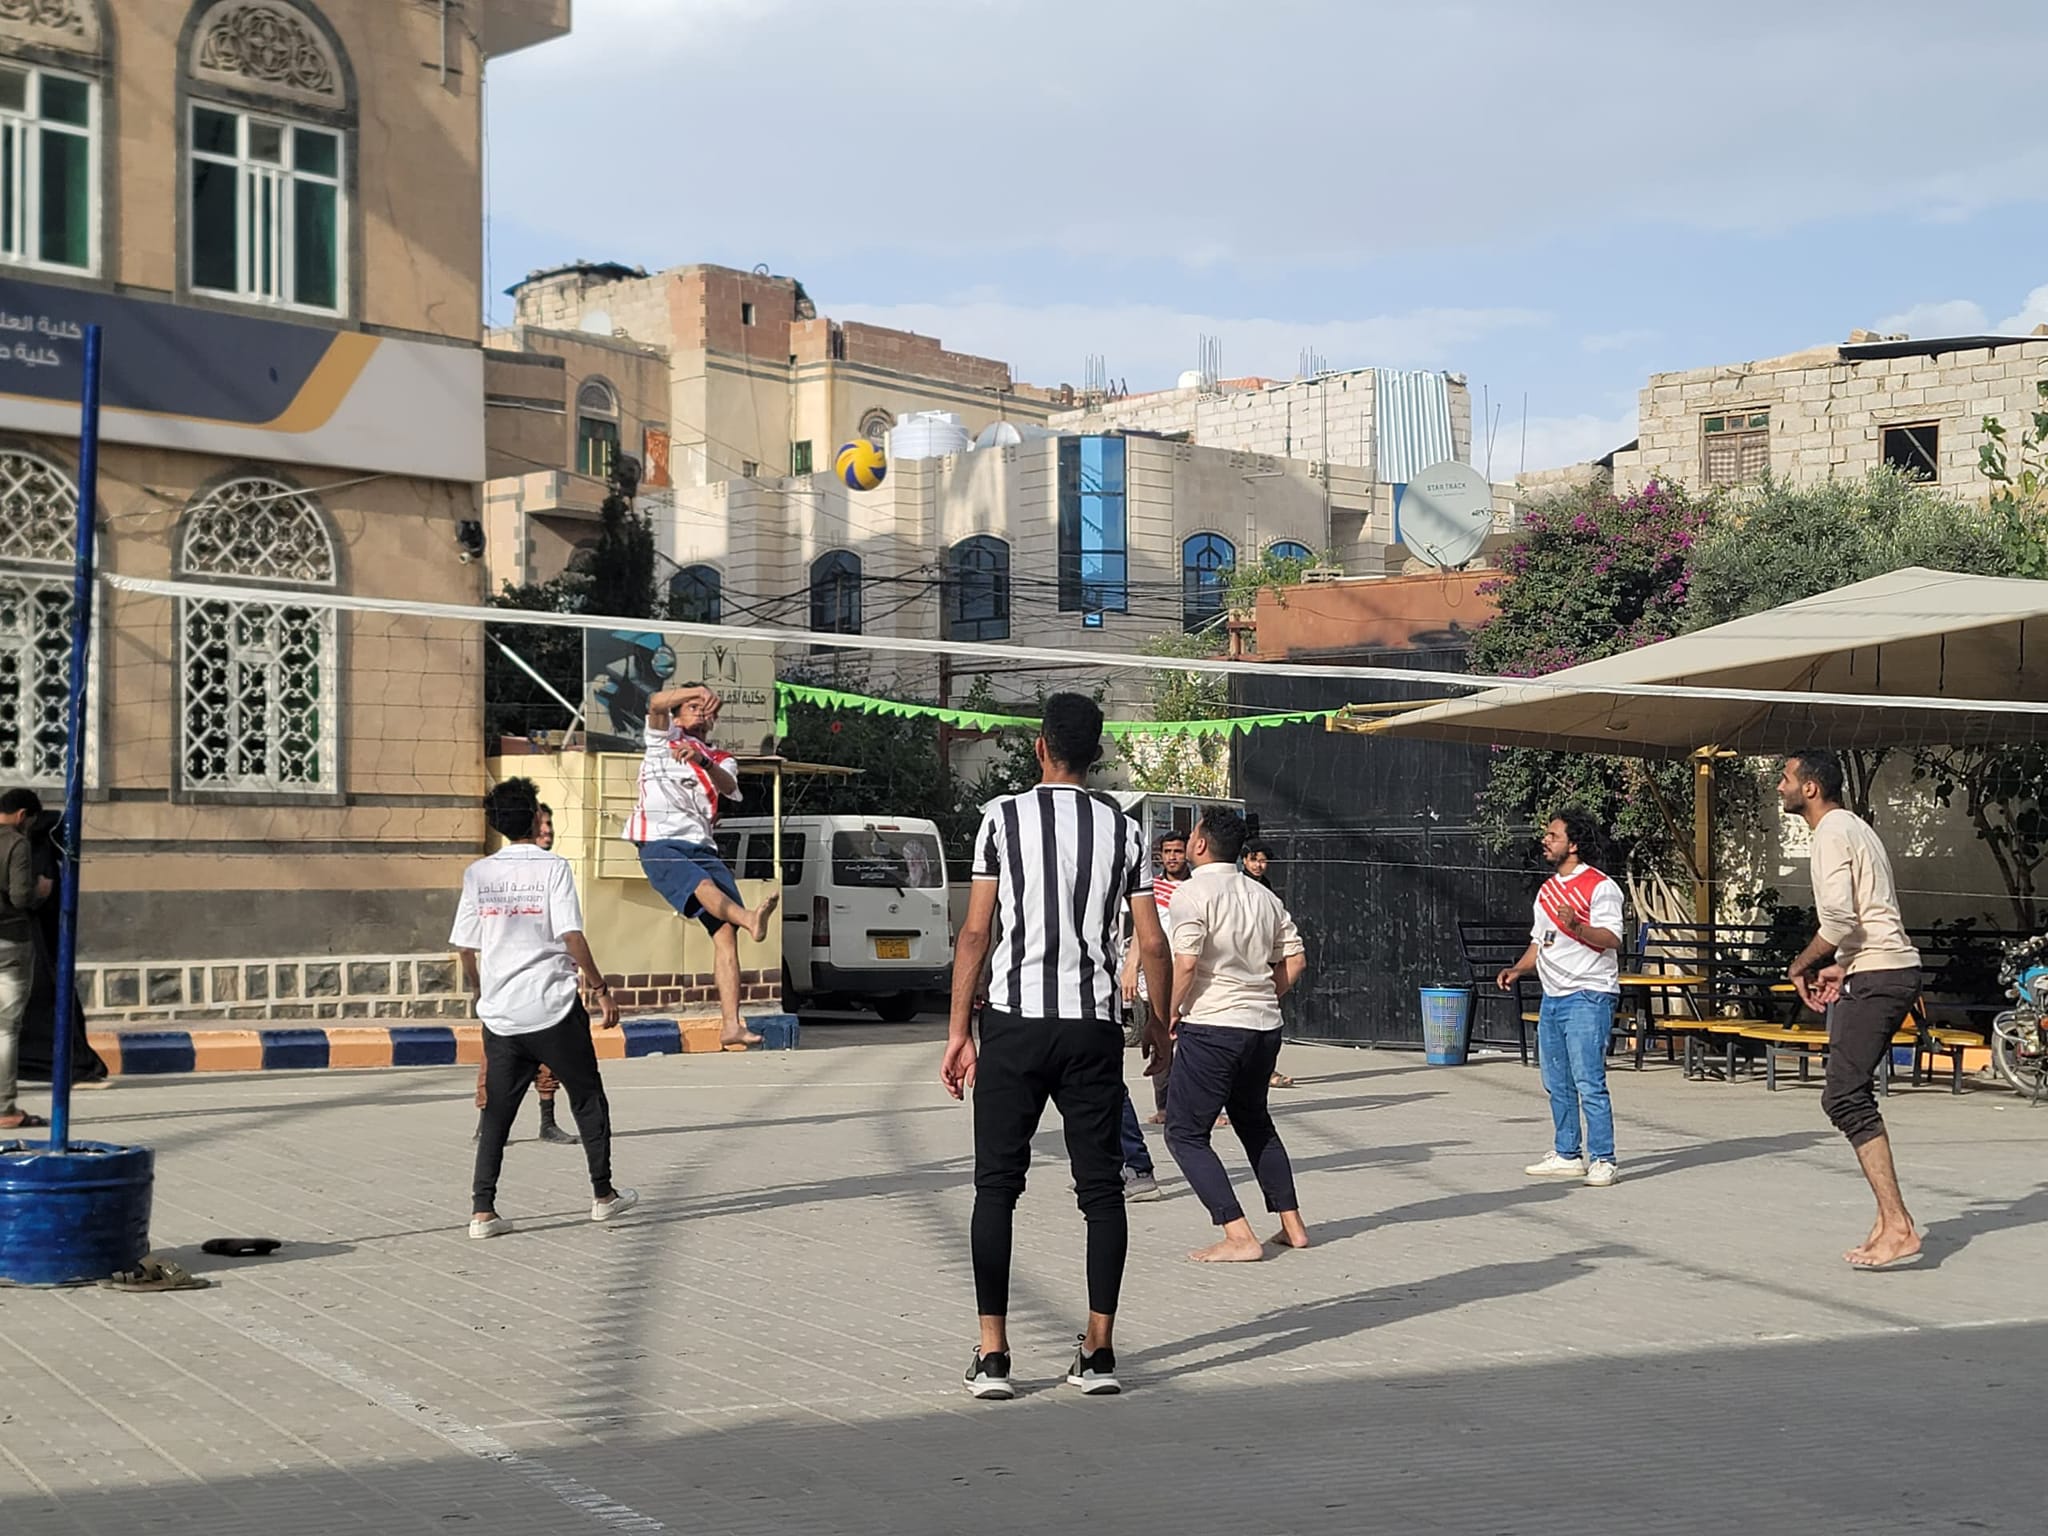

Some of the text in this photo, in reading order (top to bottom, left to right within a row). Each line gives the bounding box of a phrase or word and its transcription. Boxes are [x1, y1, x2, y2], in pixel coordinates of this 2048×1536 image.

[38, 316, 82, 340] كلية
[15, 342, 60, 367] كلية
[742, 689, 766, 708] مكتبة
[478, 881, 545, 895] جامعة الناصر
[504, 904, 519, 918] كرة
